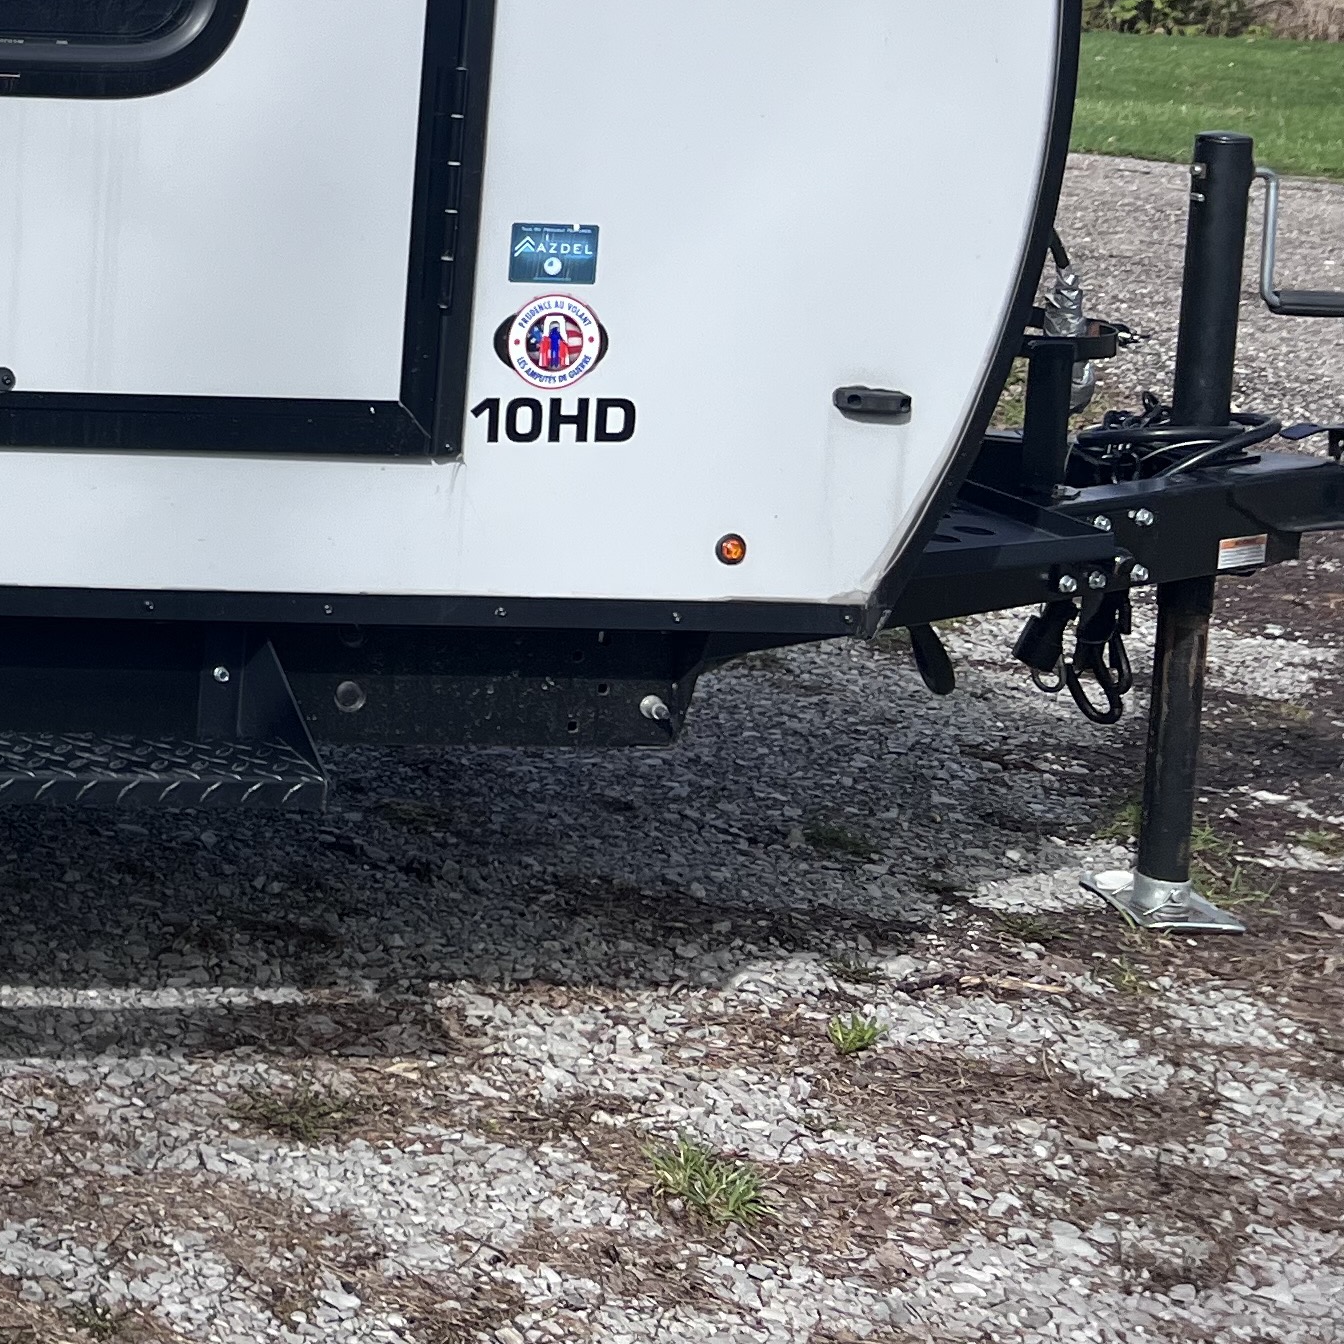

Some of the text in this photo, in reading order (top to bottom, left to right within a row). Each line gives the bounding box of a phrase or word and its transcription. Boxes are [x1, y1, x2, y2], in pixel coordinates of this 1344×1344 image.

[536, 242, 593, 255] AZDEL
[518, 300, 592, 328] PRUDENCE AU VOLANT
[470, 397, 636, 443] 10HD
